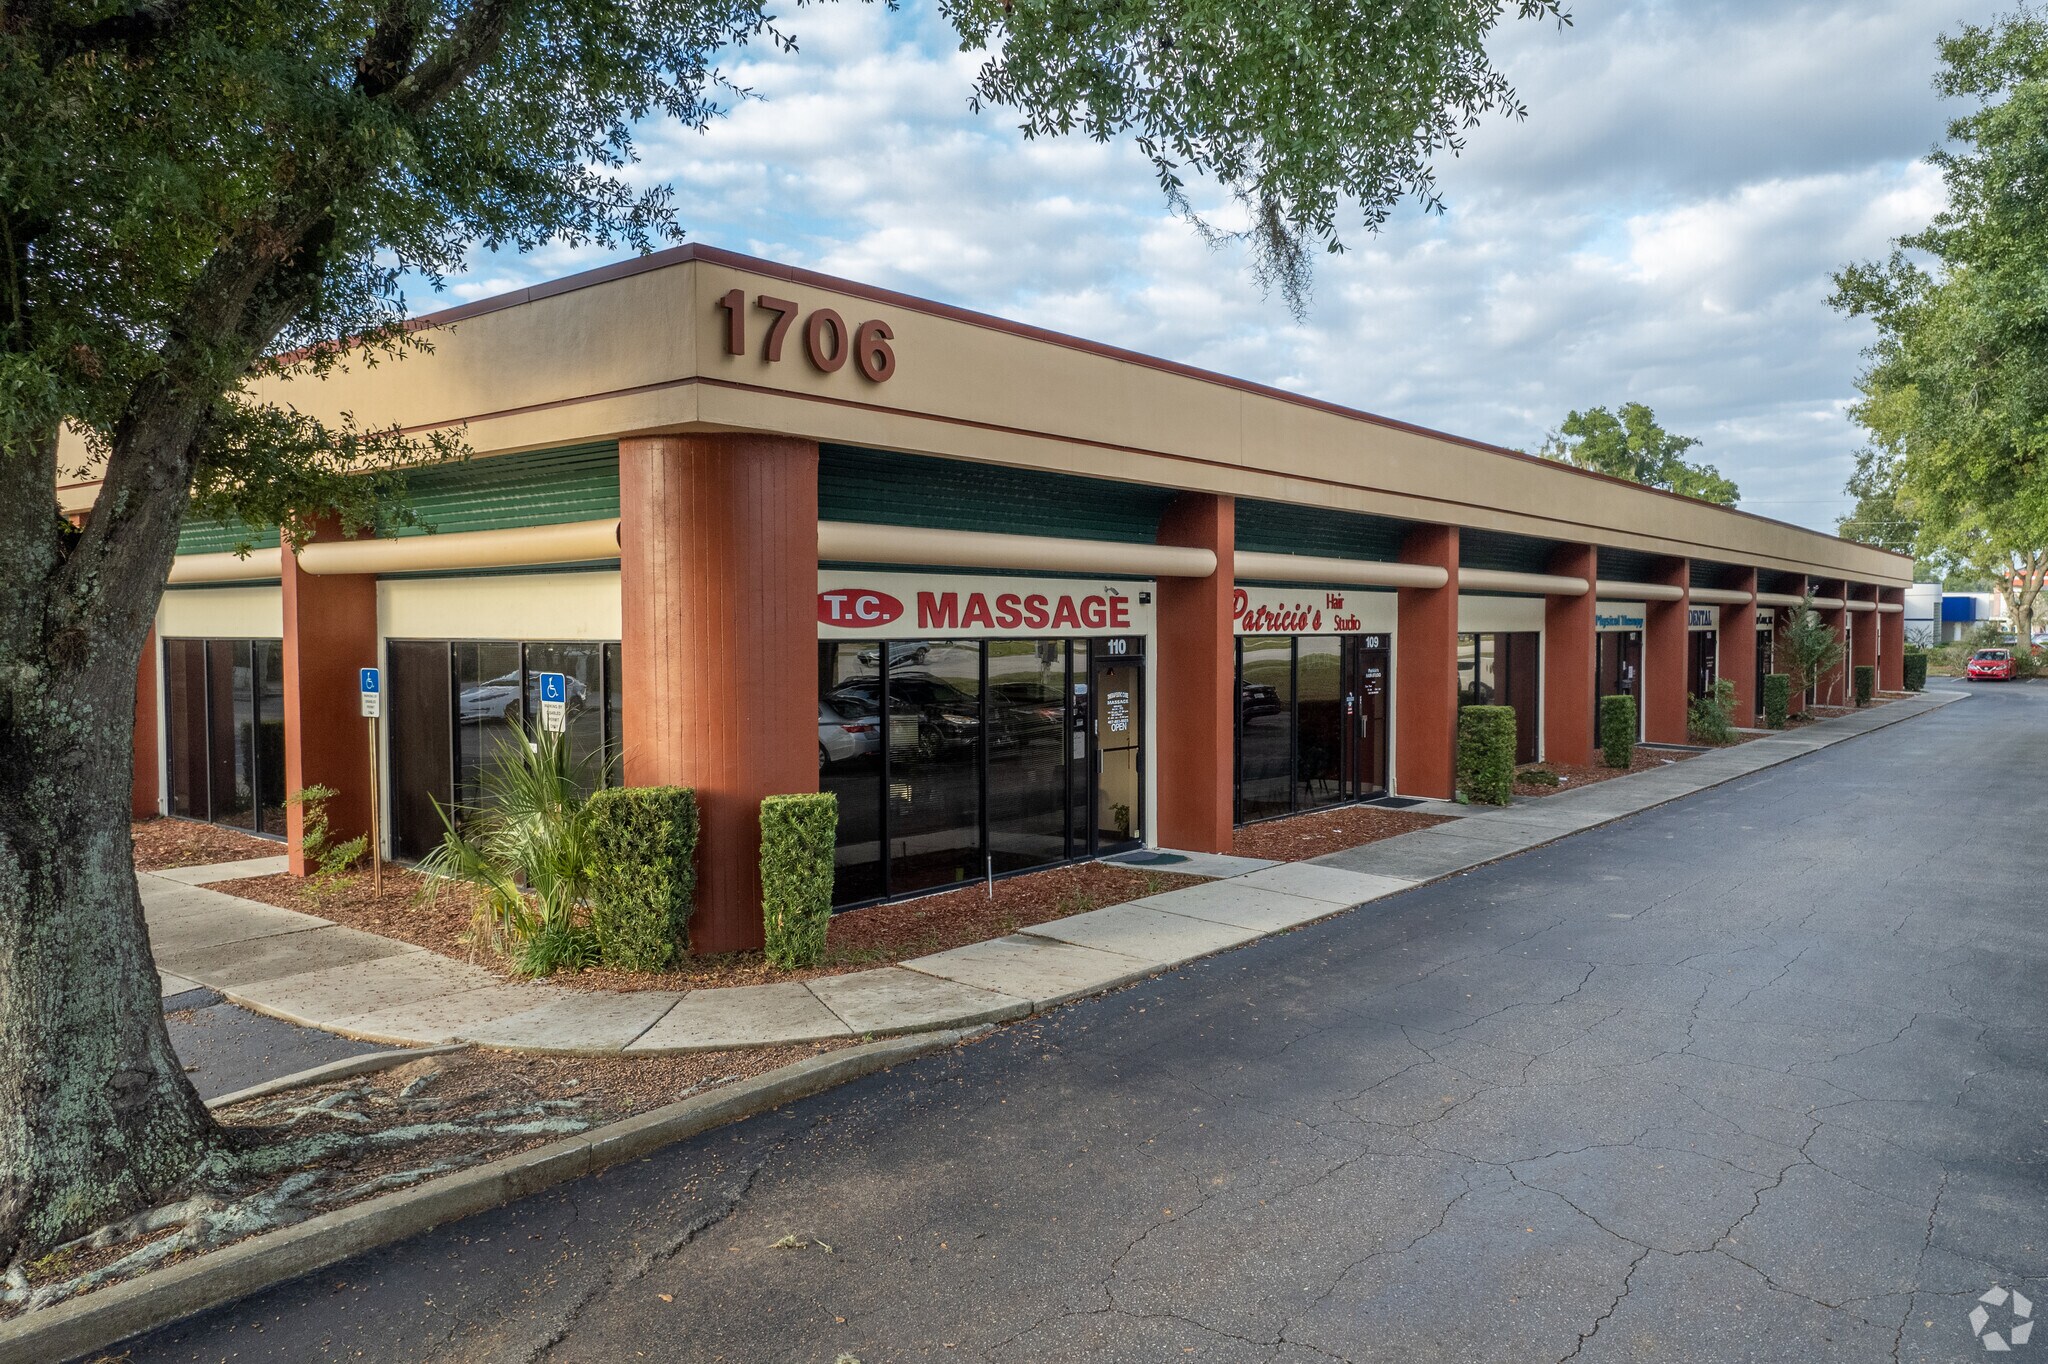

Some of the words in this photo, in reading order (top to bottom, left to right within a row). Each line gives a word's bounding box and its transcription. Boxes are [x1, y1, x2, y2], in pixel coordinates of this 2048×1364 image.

[720, 288, 896, 383] 1706
[1326, 593, 1344, 609] Hair
[823, 595, 890, 620] T.C.
[917, 591, 1131, 628] MASSAGE
[1334, 614, 1361, 631] Studio
[1595, 615, 1620, 628] Physical
[1689, 610, 1713, 626] DENTAL
[1108, 639, 1126, 654] 110
[1366, 636, 1379, 648] 109
[1111, 723, 1127, 732] OPEN
